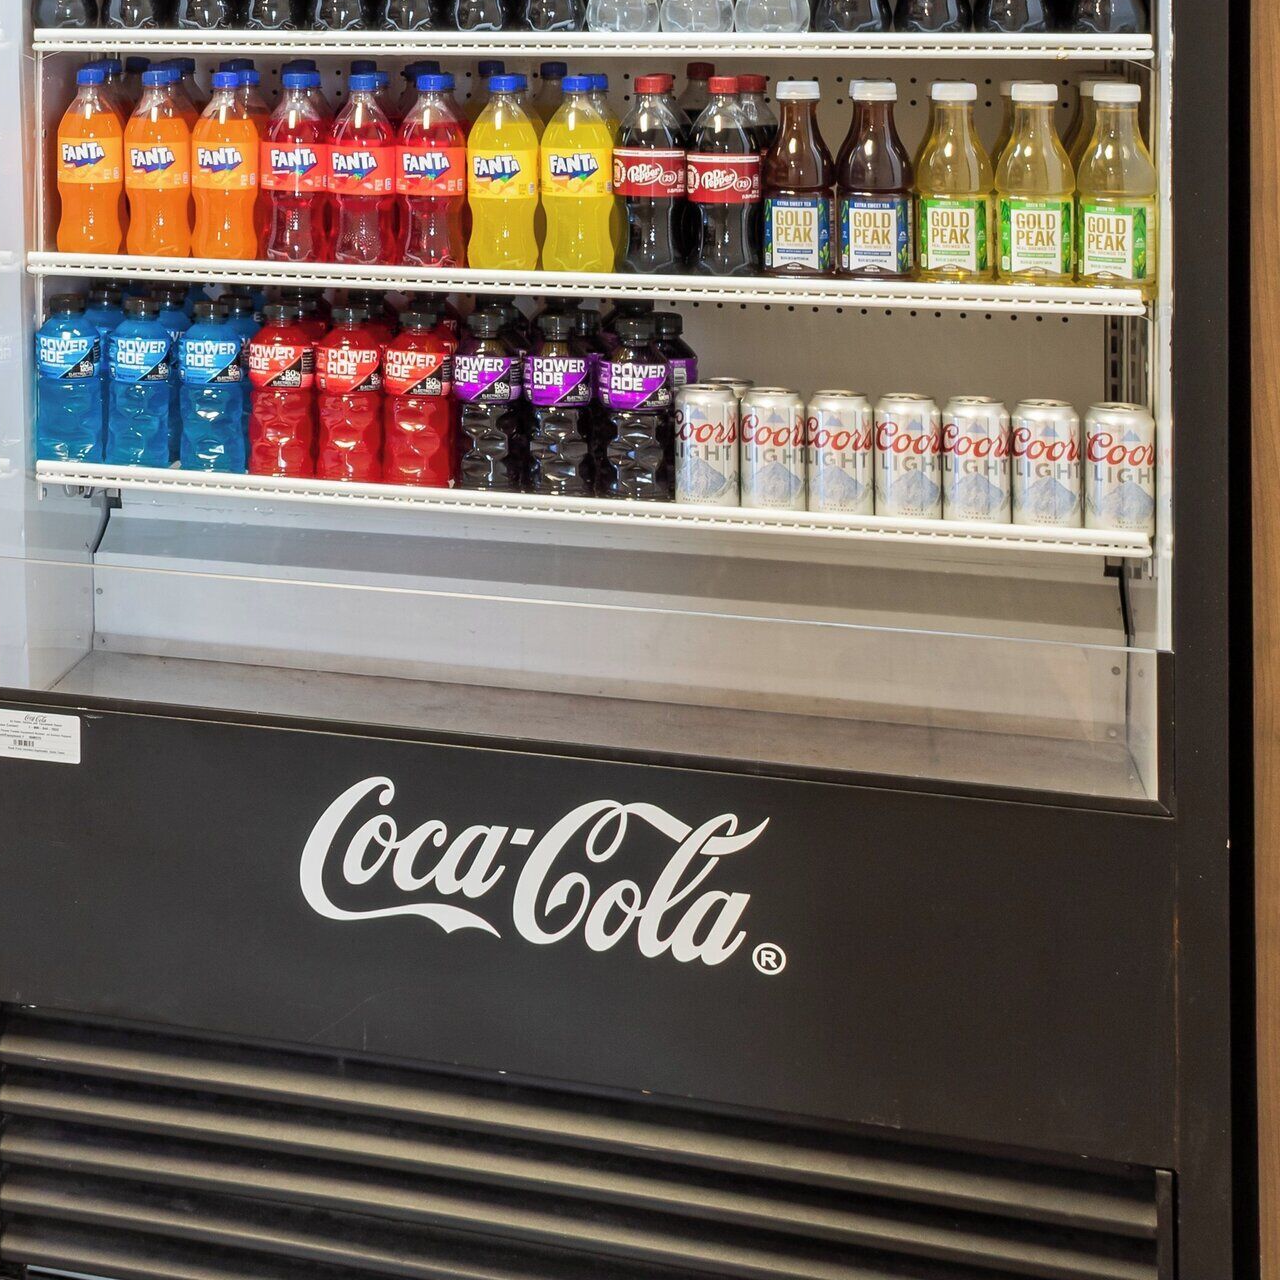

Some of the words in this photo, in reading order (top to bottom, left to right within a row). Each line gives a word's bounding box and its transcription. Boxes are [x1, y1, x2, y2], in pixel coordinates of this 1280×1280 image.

[61, 142, 106, 161] FANTA
[549, 153, 598, 173] FANTA
[703, 172, 735, 189] Pepper
[776, 210, 813, 227] GOLD
[776, 227, 813, 243] PEAK
[40, 338, 88, 352] POWER
[40, 351, 64, 364] ADE
[533, 358, 585, 373] POWER
[806, 416, 874, 451] Coors
[299, 775, 770, 965] Coca-Cola
